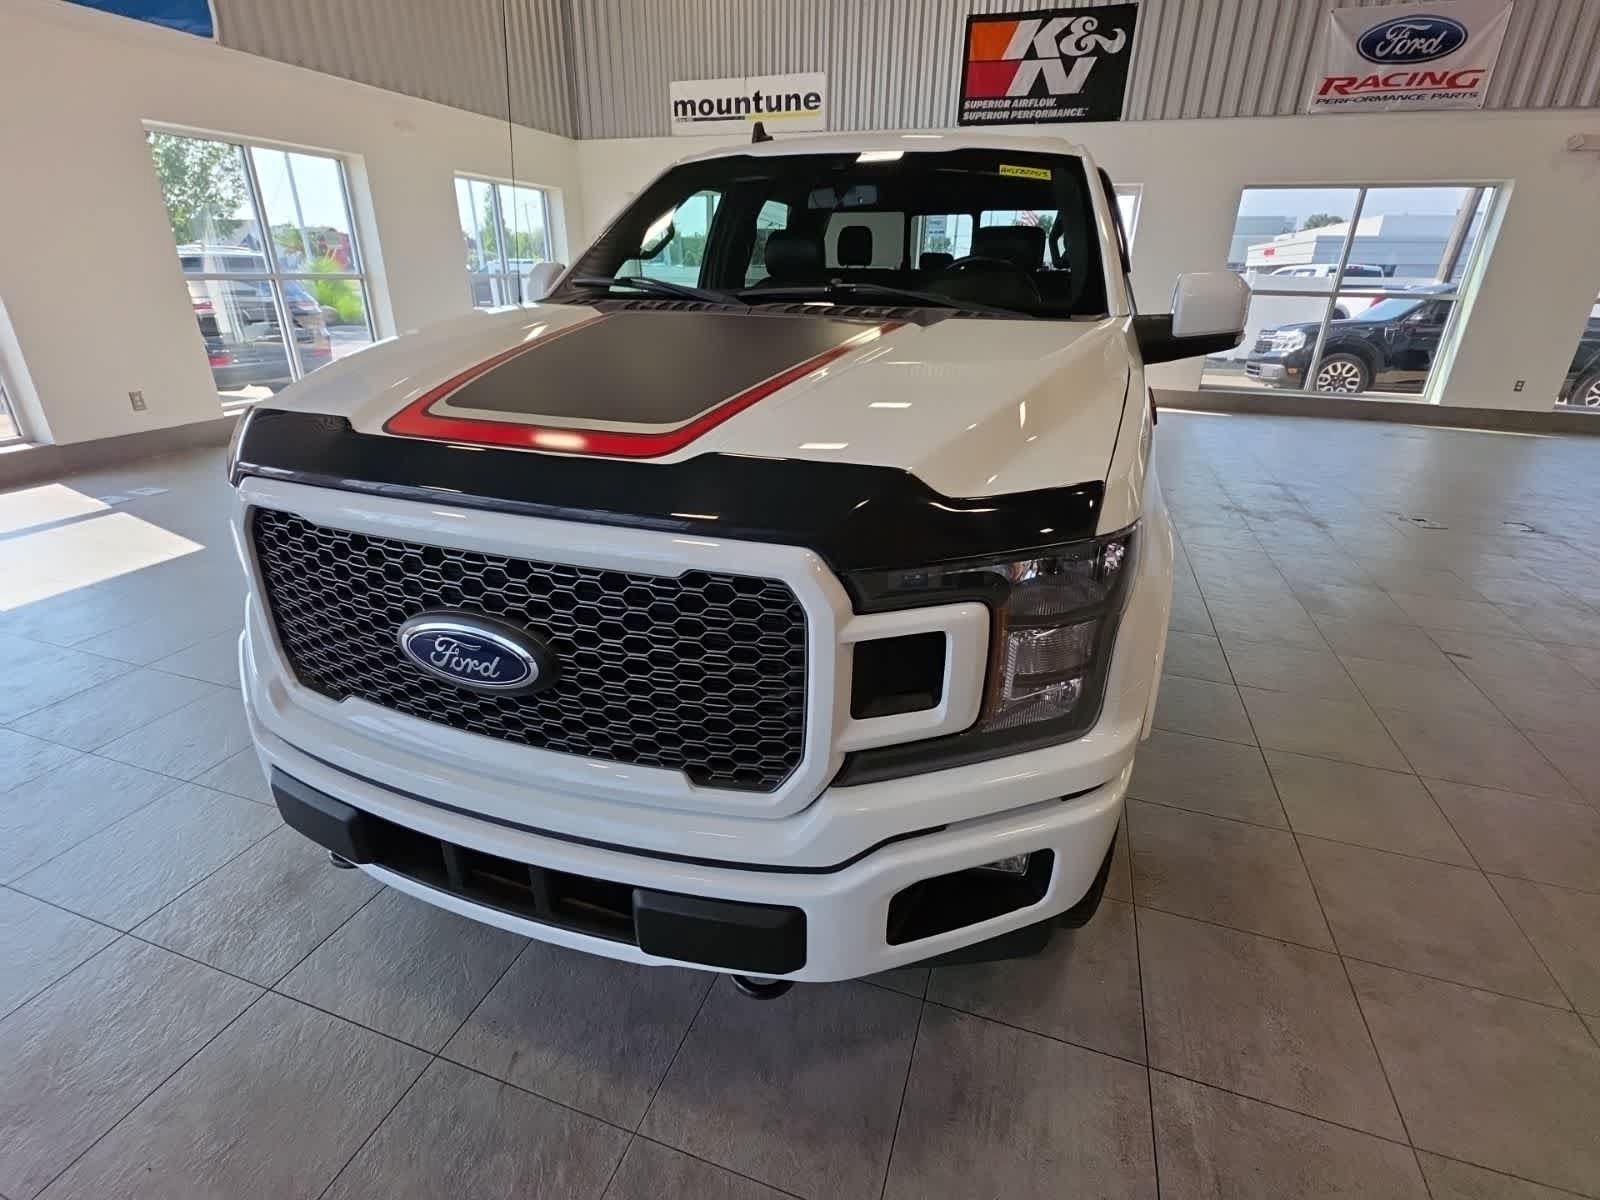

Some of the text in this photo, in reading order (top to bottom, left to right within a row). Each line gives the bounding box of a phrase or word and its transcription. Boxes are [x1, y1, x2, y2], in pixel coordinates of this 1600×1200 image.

[1375, 23, 1448, 57] Ford
[1318, 69, 1486, 96] RACING
[673, 90, 822, 117] mountune
[964, 97, 1057, 110] SUPERIOR AIRFLOW.
[1315, 91, 1479, 105] PERFORMANCE PARTS
[962, 110, 1009, 121] SUPERIOR
[429, 635, 501, 678] Ford
